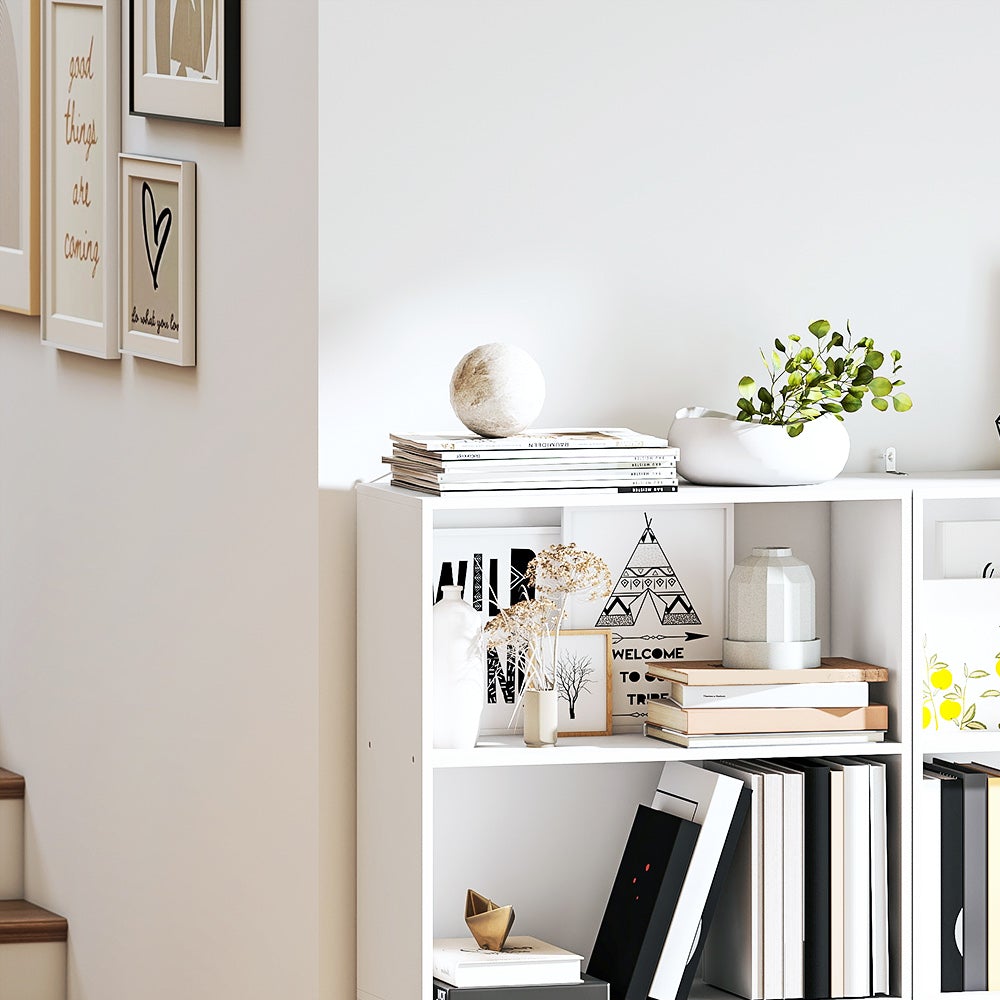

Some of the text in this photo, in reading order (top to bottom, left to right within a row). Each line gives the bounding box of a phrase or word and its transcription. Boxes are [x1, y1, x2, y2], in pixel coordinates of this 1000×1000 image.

[68, 35, 94, 94] good
[64, 98, 98, 162] things
[72, 175, 92, 208] are
[64, 230, 100, 279] coming
[140, 308, 156, 327] what
[156, 318, 169, 335] you
[169, 313, 180, 332] lov
[612, 647, 684, 660] WELCOME
[620, 671, 641, 683] TO
